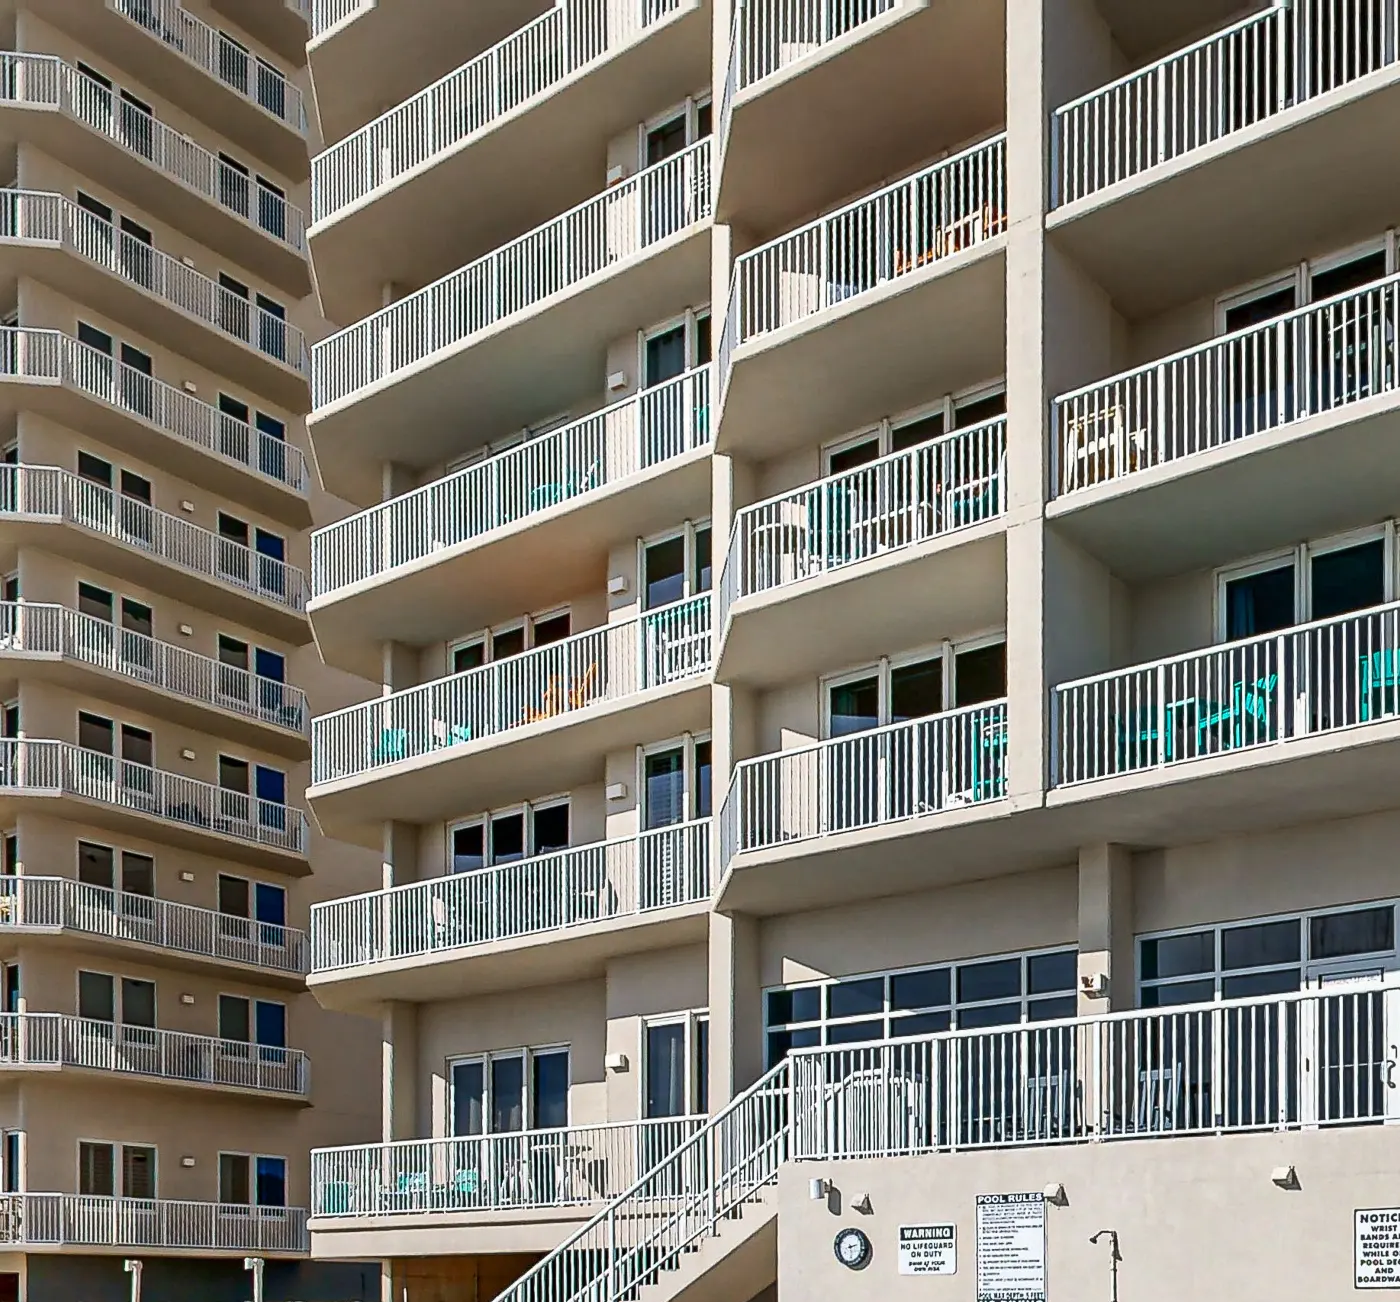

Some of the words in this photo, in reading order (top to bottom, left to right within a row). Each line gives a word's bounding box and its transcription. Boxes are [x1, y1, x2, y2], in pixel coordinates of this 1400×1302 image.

[977, 1195, 1005, 1204] POOL
[1008, 1193, 1043, 1203] RULES
[904, 1228, 951, 1239] WARNING
[1360, 1233, 1389, 1241] BANDS
[913, 1242, 953, 1250] LIFEGUARD
[1363, 1250, 1389, 1258] WHILE
